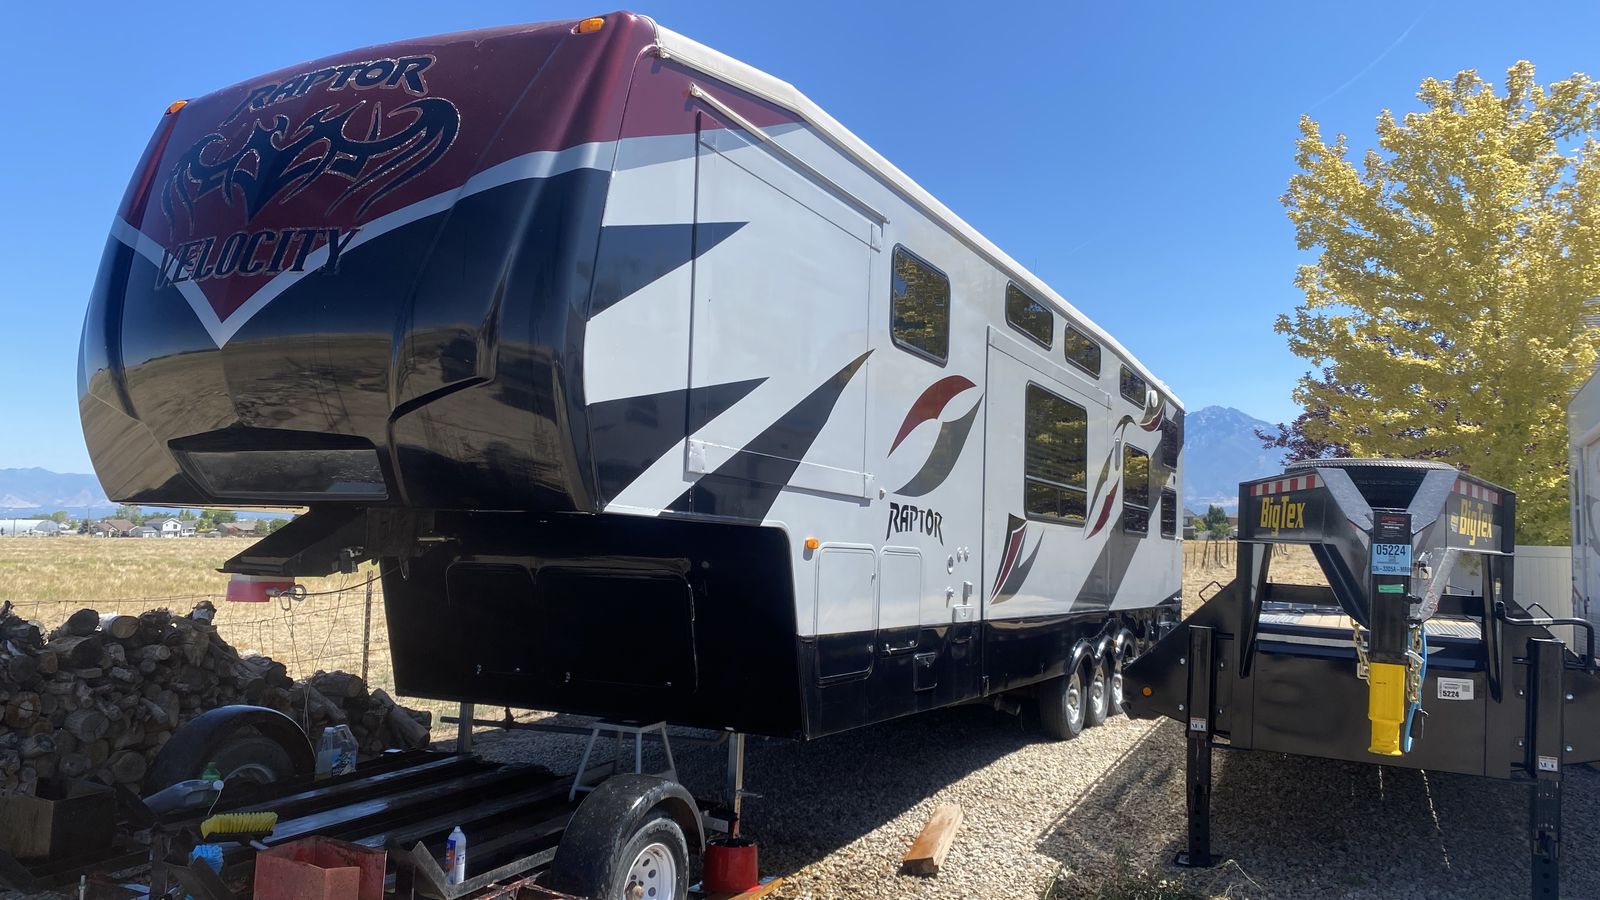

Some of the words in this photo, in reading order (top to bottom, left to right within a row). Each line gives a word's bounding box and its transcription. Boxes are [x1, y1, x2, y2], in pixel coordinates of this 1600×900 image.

[217, 54, 437, 128] RAPTOR
[154, 225, 365, 289] VELOCITY
[886, 501, 944, 547] RAPTOR
[1376, 544, 1407, 556] 05224
[1442, 690, 1460, 698] 5224
